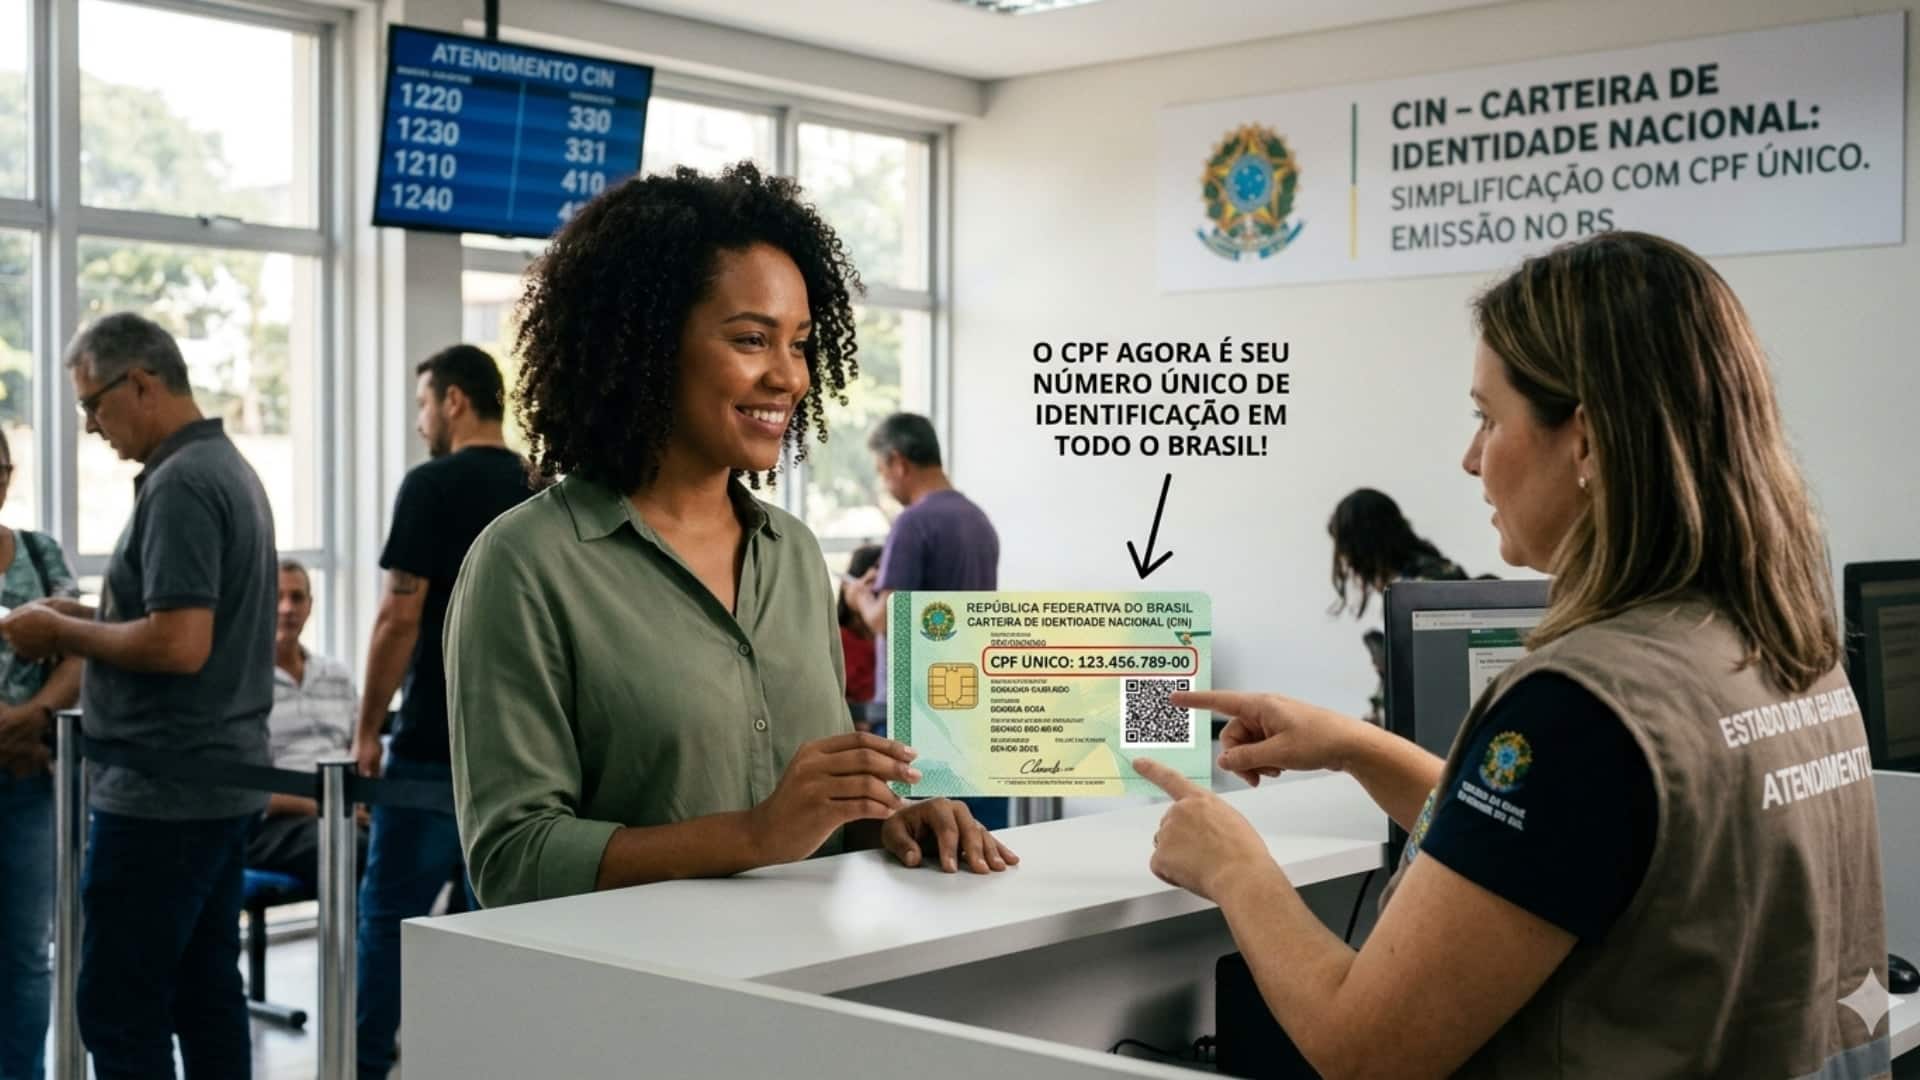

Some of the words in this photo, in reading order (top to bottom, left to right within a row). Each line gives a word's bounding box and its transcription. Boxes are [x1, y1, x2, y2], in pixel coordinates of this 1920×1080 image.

[432, 43, 578, 82] ATENDIMENTO
[581, 66, 615, 88] CIN
[401, 82, 463, 113] 1220
[1392, 97, 1447, 130] CIN
[1481, 72, 1660, 119] CARTEIRA
[1670, 63, 1719, 98] DE
[397, 117, 460, 146] 1230
[568, 106, 611, 133] 330
[1392, 122, 1598, 171] IDENTIDADE
[1609, 99, 1820, 149] NACIONAL:
[394, 150, 456, 179] 1210
[565, 138, 606, 164] 331
[561, 169, 605, 195] 410
[1392, 163, 1604, 211] SIMPLIFICAÇÃO
[1612, 160, 1680, 191] COM
[1689, 152, 1748, 184] CPF
[1758, 143, 1870, 178] ÚNICO.
[391, 184, 453, 212] 1240
[1392, 212, 1515, 251] EMISSÃO
[1525, 212, 1567, 241] NO
[966, 600, 1039, 614] REPÚBLICA
[1043, 602, 1121, 614] FEDERATIVA
[1124, 602, 1143, 614] DO
[1147, 602, 1193, 614] BRASIL
[967, 617, 1022, 627] CARTEIRA
[1024, 617, 1039, 627] DE
[1108, 617, 1164, 627] NACIONAL
[1166, 616, 1193, 629] (CIN)
[990, 655, 1017, 668] CPF
[1078, 655, 1190, 668] 123.456.789-00
[1719, 703, 1786, 748] ESTADO
